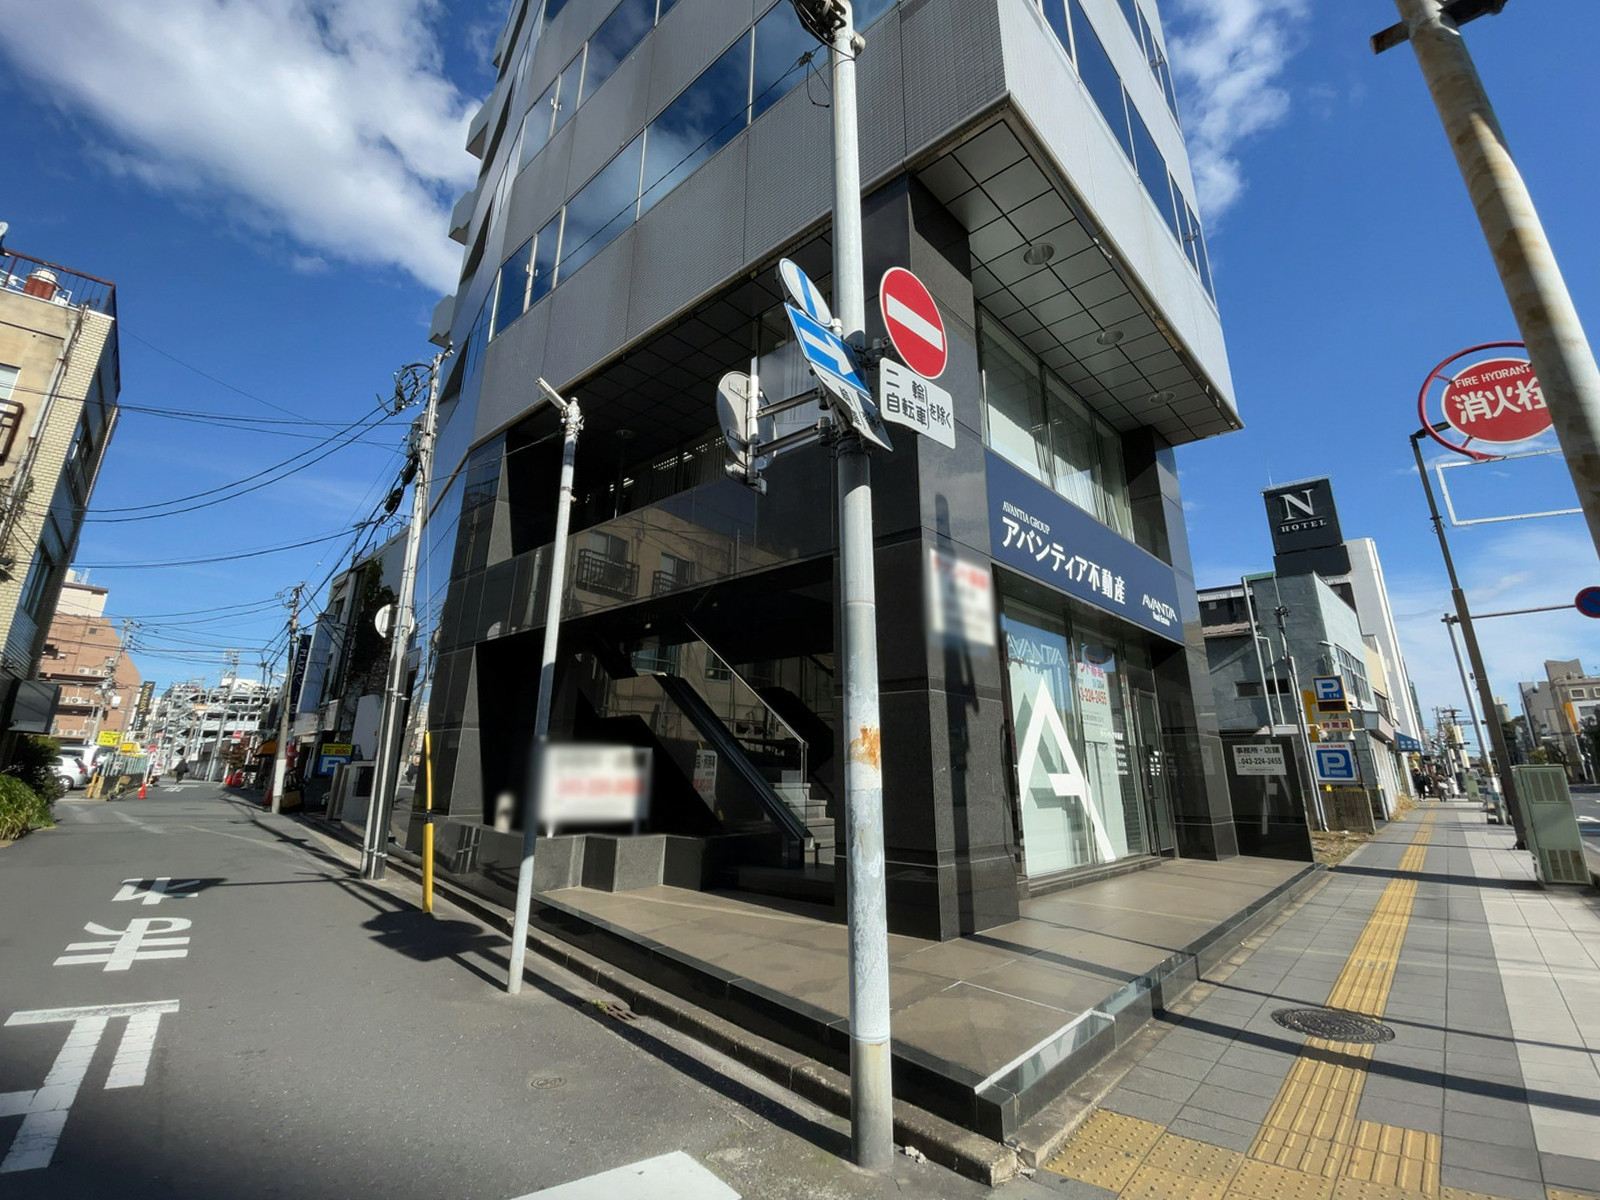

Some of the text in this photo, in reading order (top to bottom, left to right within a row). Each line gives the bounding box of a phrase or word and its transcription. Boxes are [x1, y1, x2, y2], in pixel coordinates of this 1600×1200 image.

[1455, 364, 1531, 389] FIRE HYDRANT
[886, 392, 927, 426] 自転車
[929, 402, 952, 429] を除く
[1452, 377, 1547, 425] 消火栓
[1002, 500, 1051, 536] AVANTIA GROUP
[1279, 488, 1315, 521] N
[1281, 518, 1328, 533] HOTEL
[1002, 516, 1126, 605] アバンティア不動産
[1142, 593, 1179, 623] AVANTIA
[294, 648, 308, 681] PLAZA
[1006, 631, 1067, 669] AVANTIA
[1316, 679, 1339, 699] P
[1320, 752, 1345, 776] P
